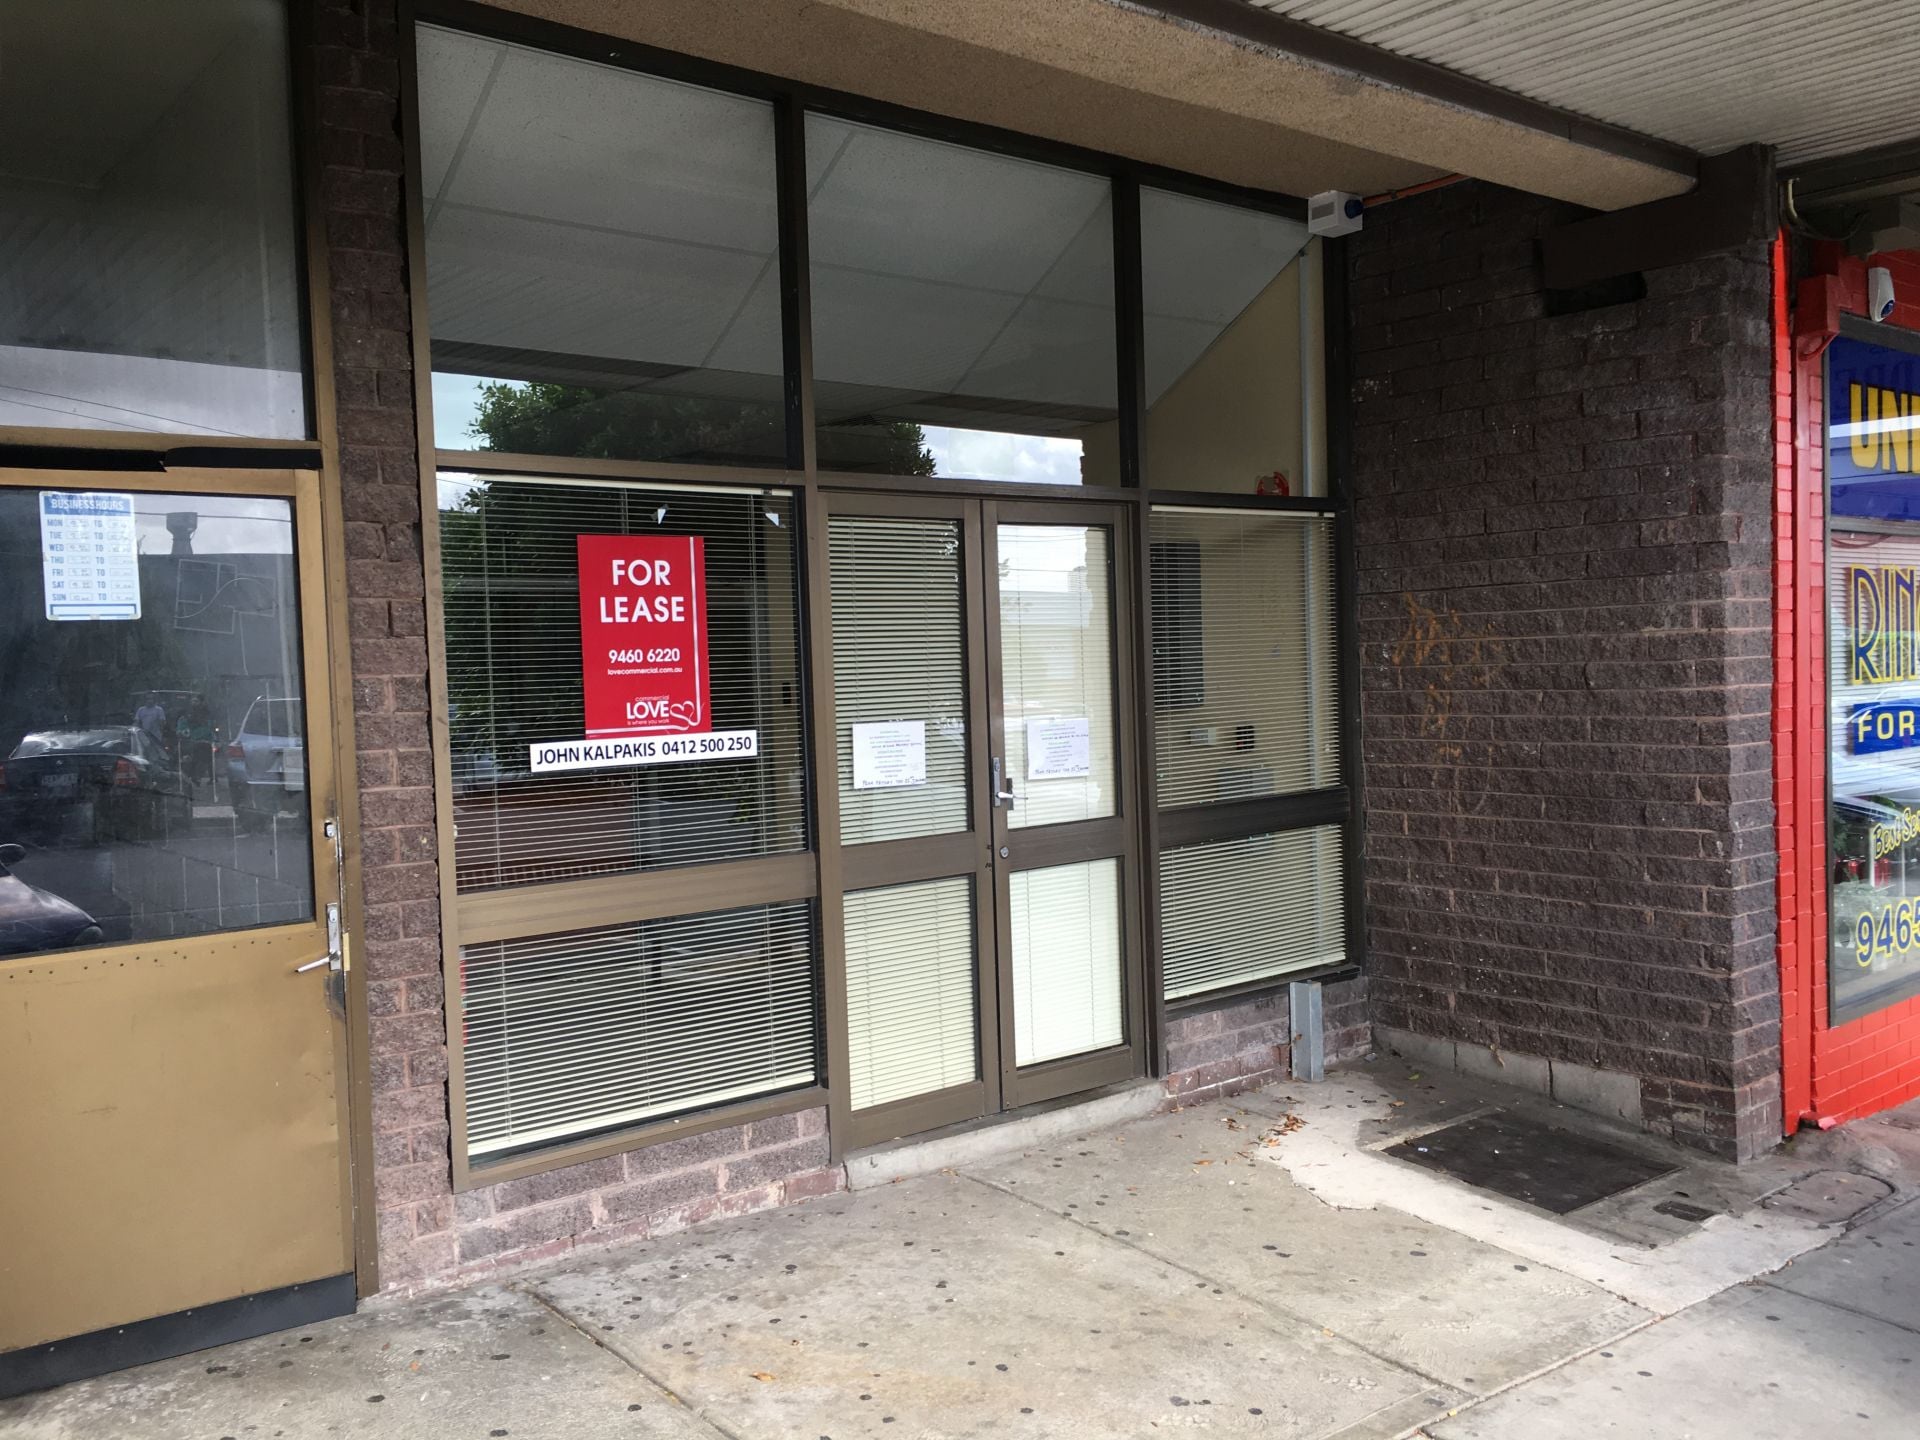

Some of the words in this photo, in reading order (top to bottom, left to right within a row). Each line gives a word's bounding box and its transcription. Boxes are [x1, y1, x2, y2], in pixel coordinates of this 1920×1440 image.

[51, 499, 94, 509] BUSINESS
[96, 500, 124, 510] HOURS
[47, 519, 63, 527] MON
[94, 520, 102, 528] TO
[50, 531, 62, 539] TUE
[95, 532, 103, 540] TO
[95, 544, 104, 552] TO
[52, 568, 64, 576] FRI
[612, 559, 671, 586] FOR
[600, 596, 685, 623] LEASE
[1851, 563, 1920, 686] RIN
[609, 649, 643, 663] 9460
[647, 648, 680, 662] 6220
[607, 667, 683, 675] lovecommercial.com.au
[626, 701, 669, 719] LOVE
[1858, 710, 1916, 742] FOR
[537, 747, 580, 765] JOHN
[584, 742, 656, 761] KALPAKIS
[662, 739, 696, 756] 0412
[700, 738, 724, 752] 500
[727, 736, 751, 751] 250
[1872, 816, 1901, 859] Best
